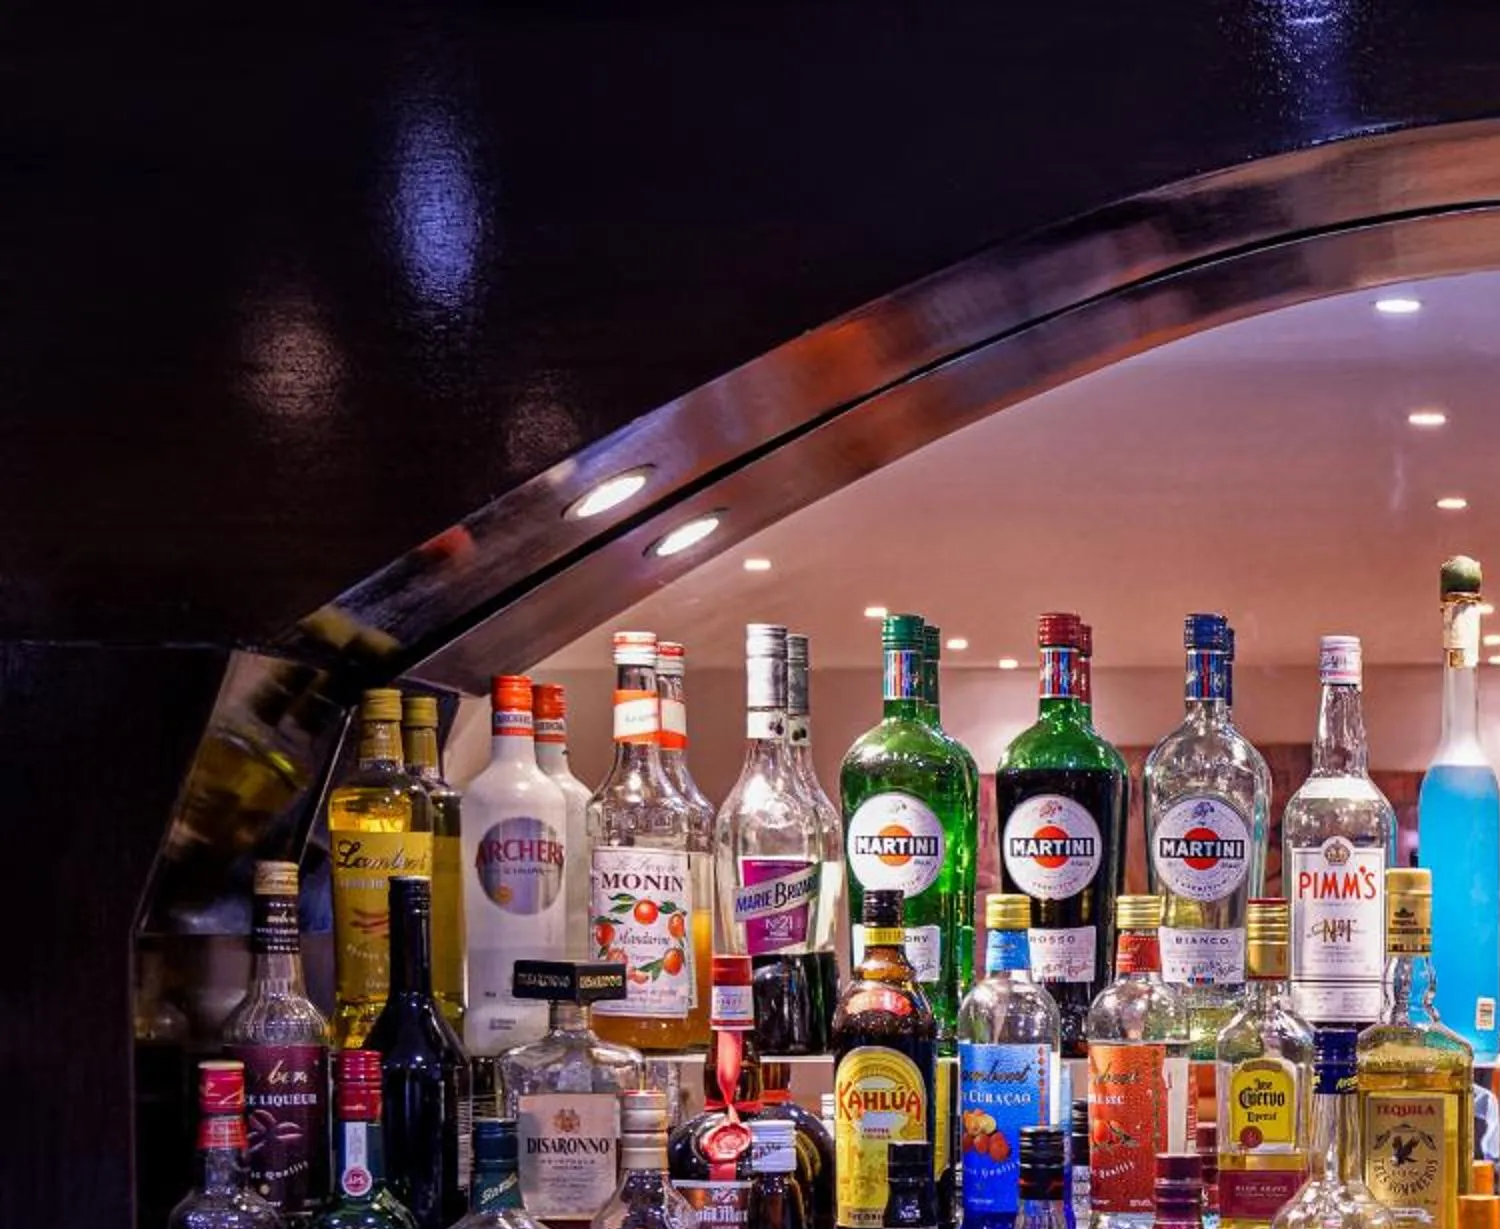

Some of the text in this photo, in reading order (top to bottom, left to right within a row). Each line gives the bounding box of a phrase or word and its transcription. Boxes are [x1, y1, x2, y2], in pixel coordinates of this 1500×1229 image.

[857, 837, 936, 854] MARTINI
[1013, 839, 1093, 857] MARTINI
[1162, 840, 1243, 858] MARTINI
[601, 873, 684, 892] MONIN
[1299, 866, 1377, 900] PIMM'S
[1175, 937, 1230, 945] BIANCO
[838, 1079, 921, 1122] KAHLÚA
[1239, 1086, 1285, 1110] Cuervo
[1377, 1103, 1435, 1117] TEQUILA
[527, 1138, 610, 1155] DISARONNO
